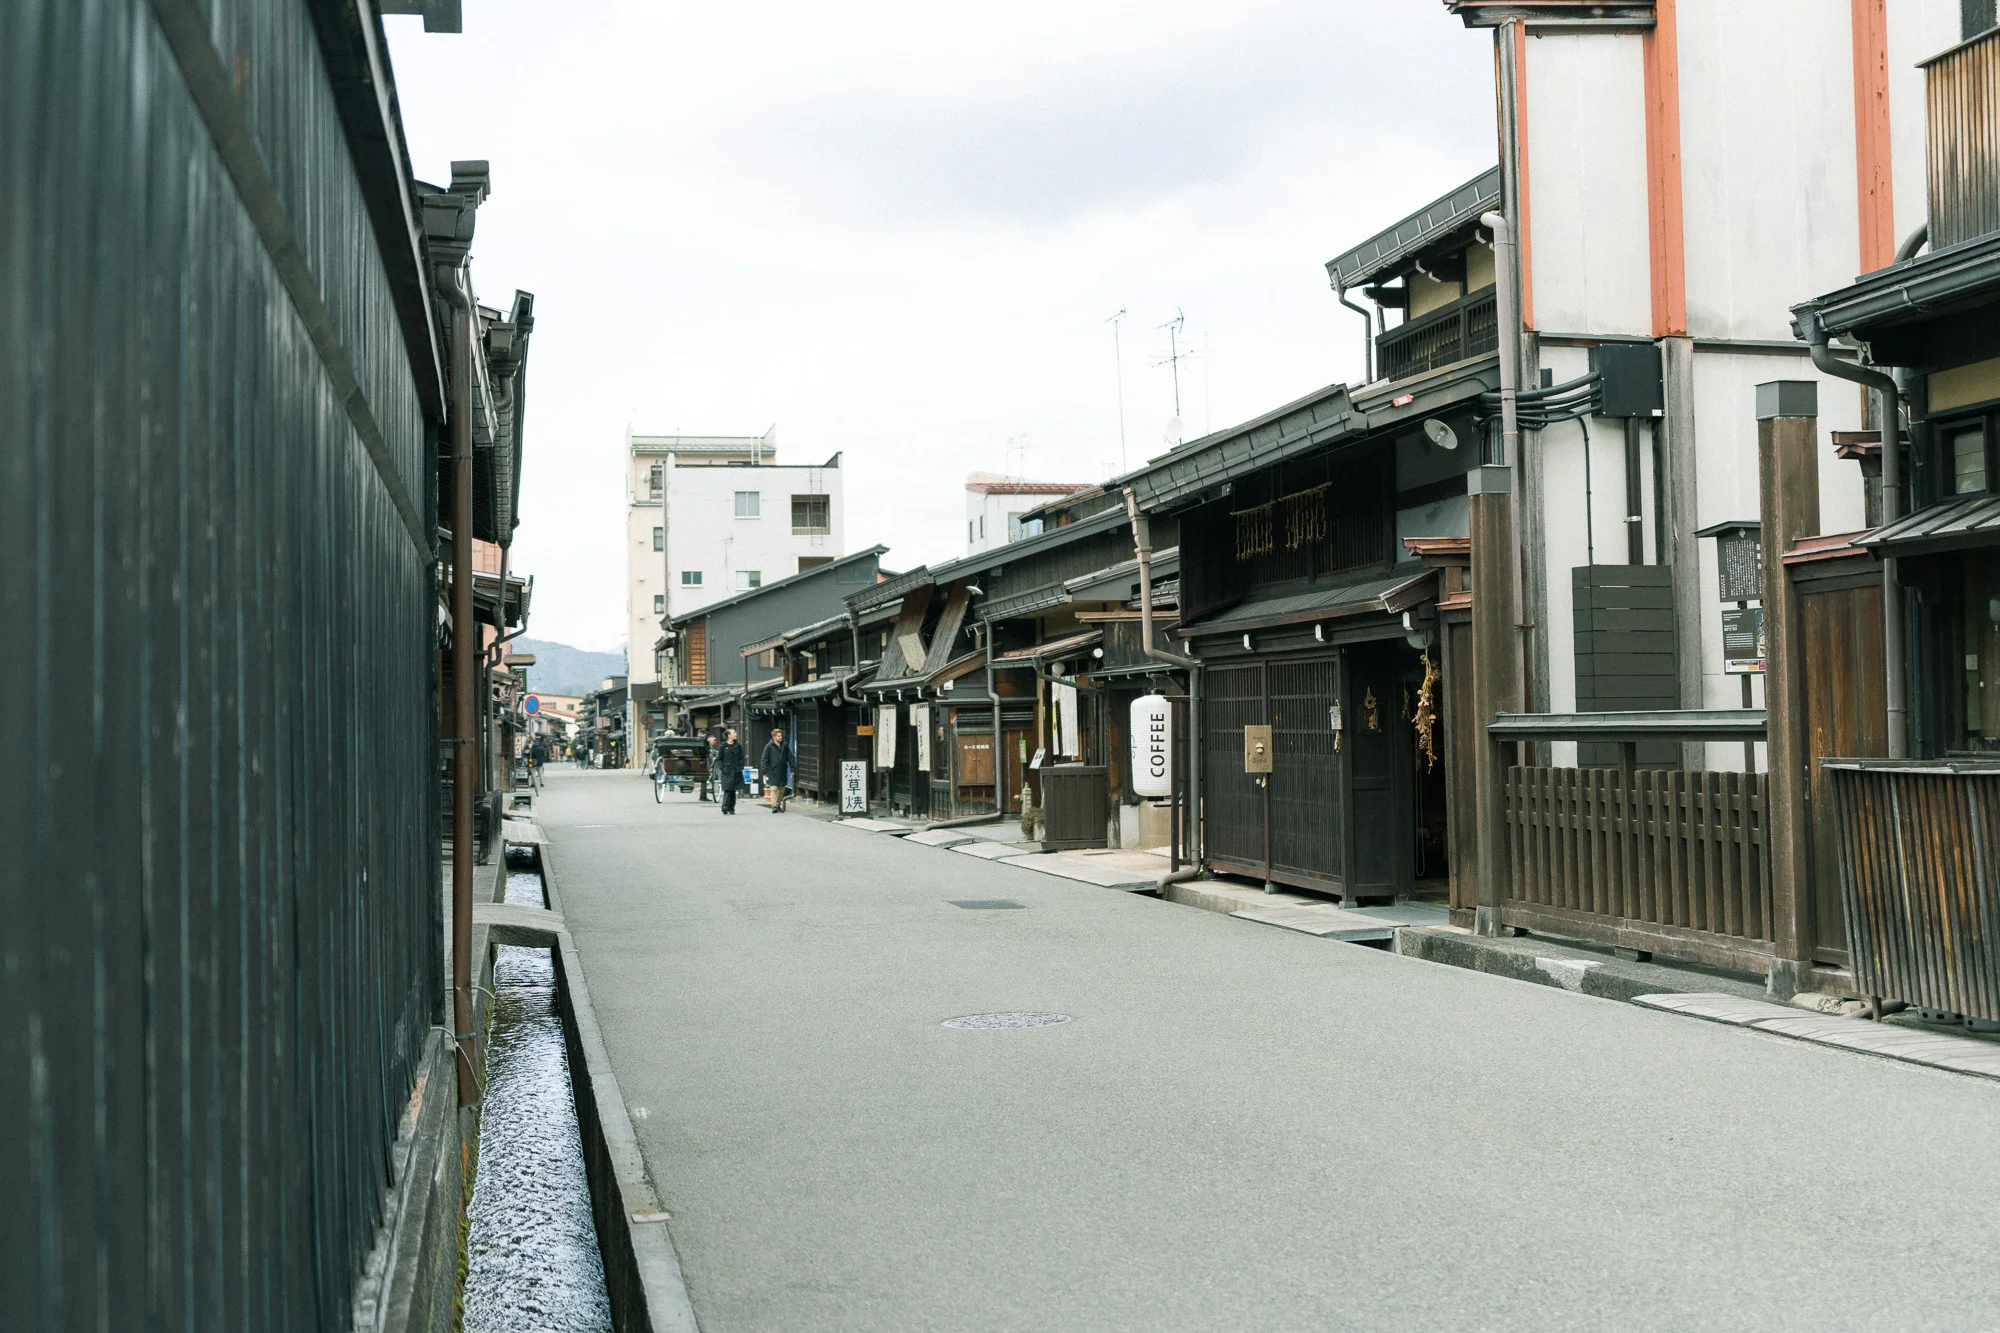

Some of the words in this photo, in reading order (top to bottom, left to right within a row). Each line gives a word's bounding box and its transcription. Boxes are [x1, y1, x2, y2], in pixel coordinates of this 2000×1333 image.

[1150, 713, 1165, 778] COFFEE
[844, 763, 864, 810] 渋草焼
